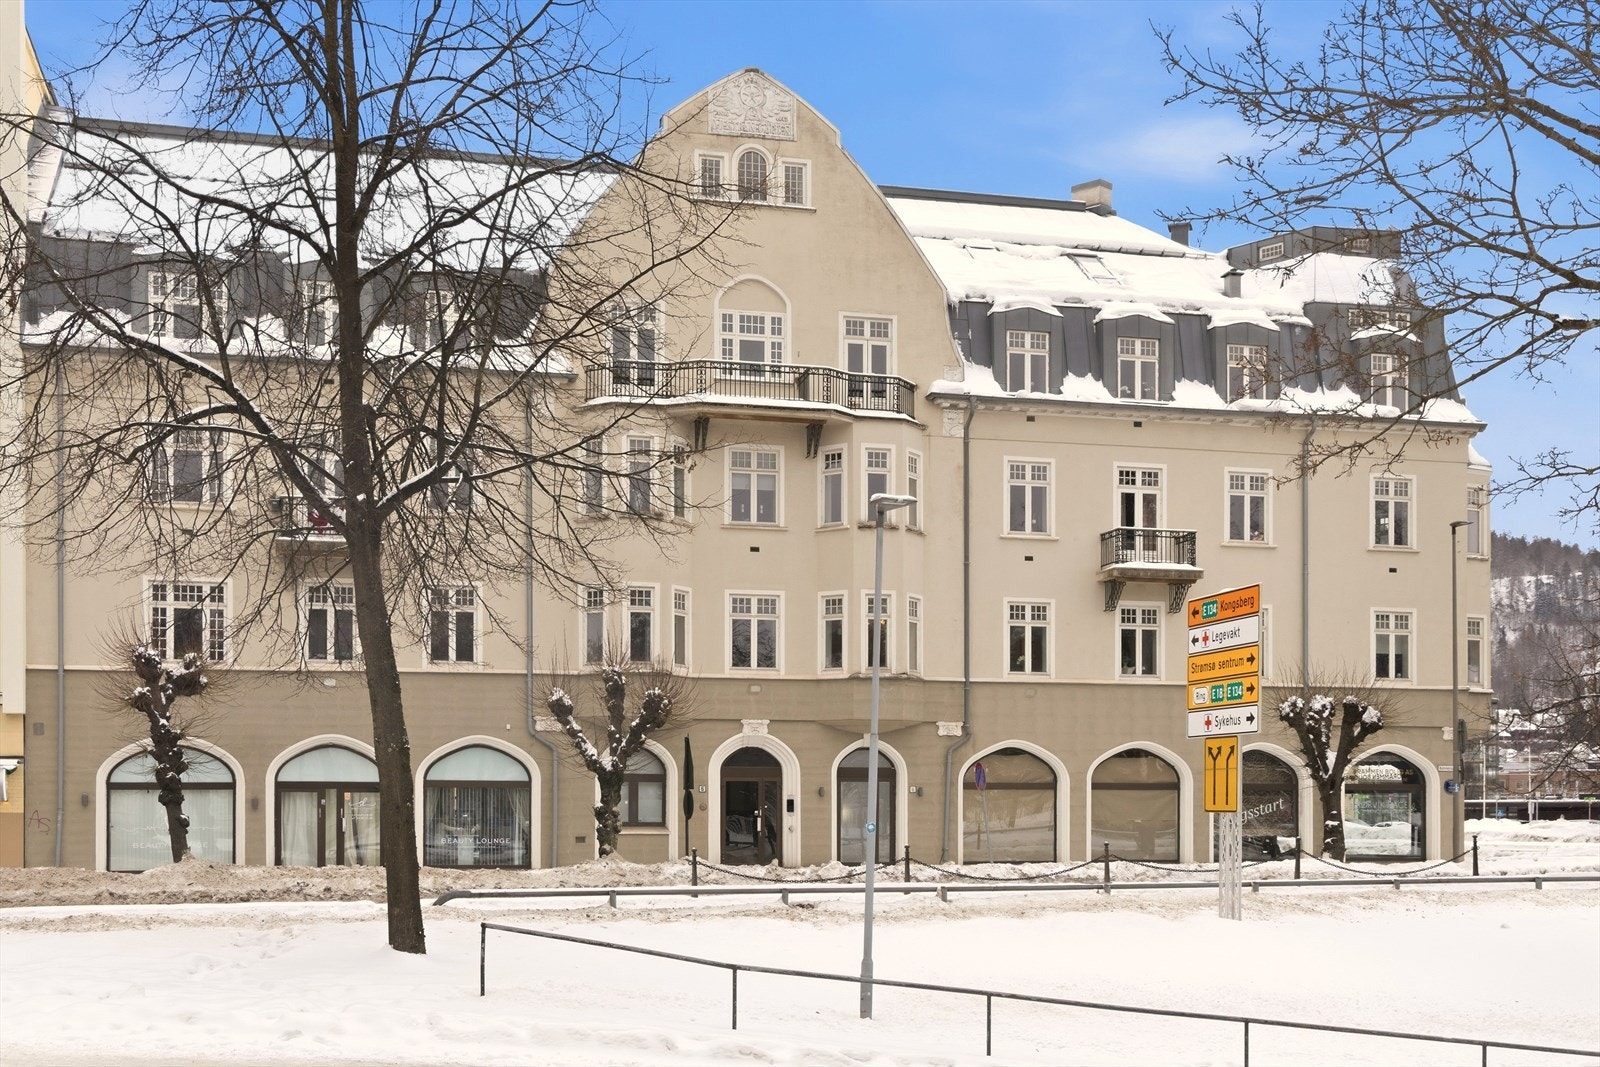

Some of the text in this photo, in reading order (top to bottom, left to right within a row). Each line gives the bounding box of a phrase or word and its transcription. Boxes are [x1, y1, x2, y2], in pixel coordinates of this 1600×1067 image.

[1220, 596, 1255, 613] Kongsberg
[1211, 626, 1241, 644] Legevakt
[1191, 656, 1245, 674] Strømsø sentrum
[1196, 692, 1206, 702] Ring
[1214, 714, 1241, 729] Sykehus
